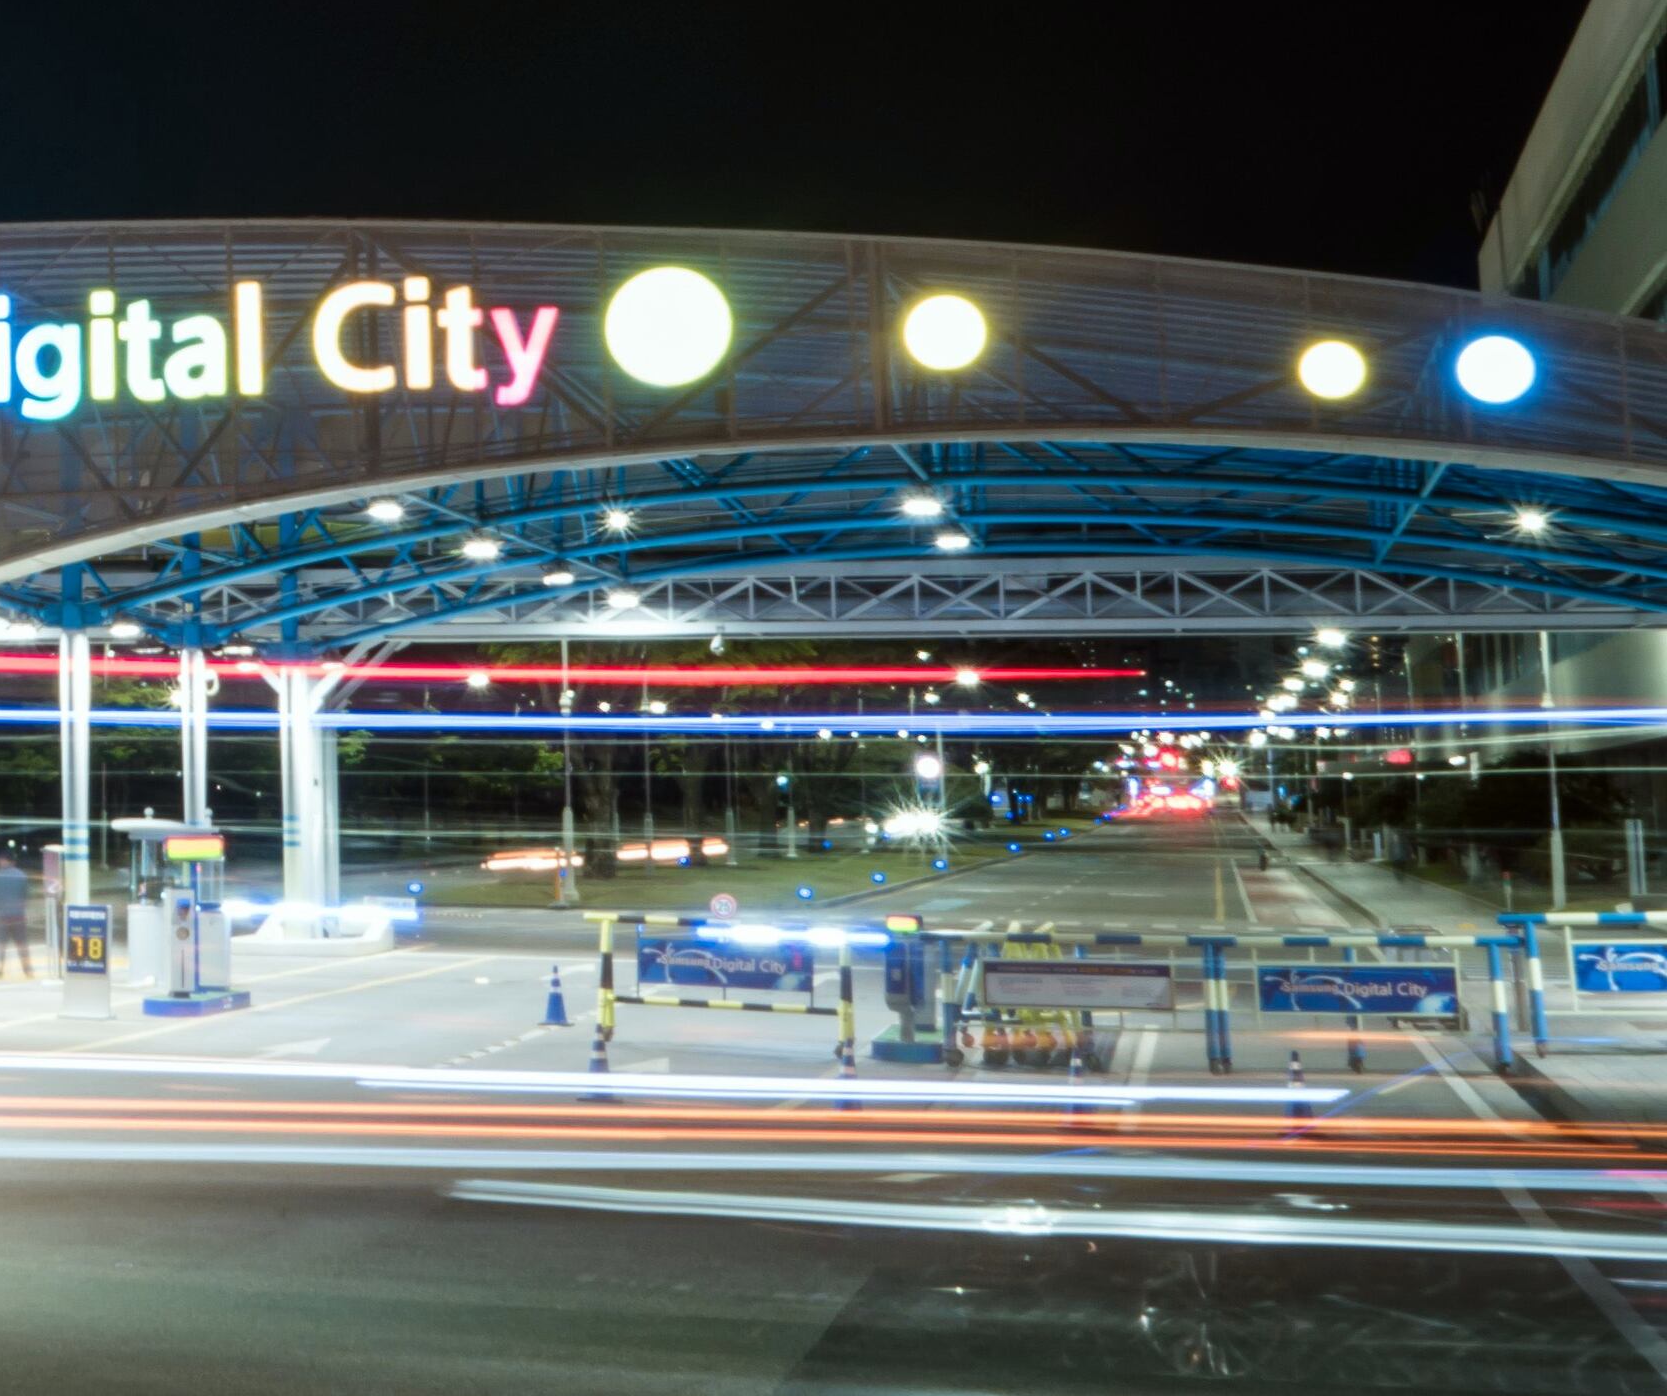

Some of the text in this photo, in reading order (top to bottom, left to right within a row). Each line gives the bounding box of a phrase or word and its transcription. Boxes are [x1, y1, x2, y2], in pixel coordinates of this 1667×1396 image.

[312, 276, 559, 406] City
[712, 957, 756, 973] Digital
[759, 959, 786, 975] City
[1343, 982, 1393, 998] Digital
[1397, 982, 1428, 998] City
